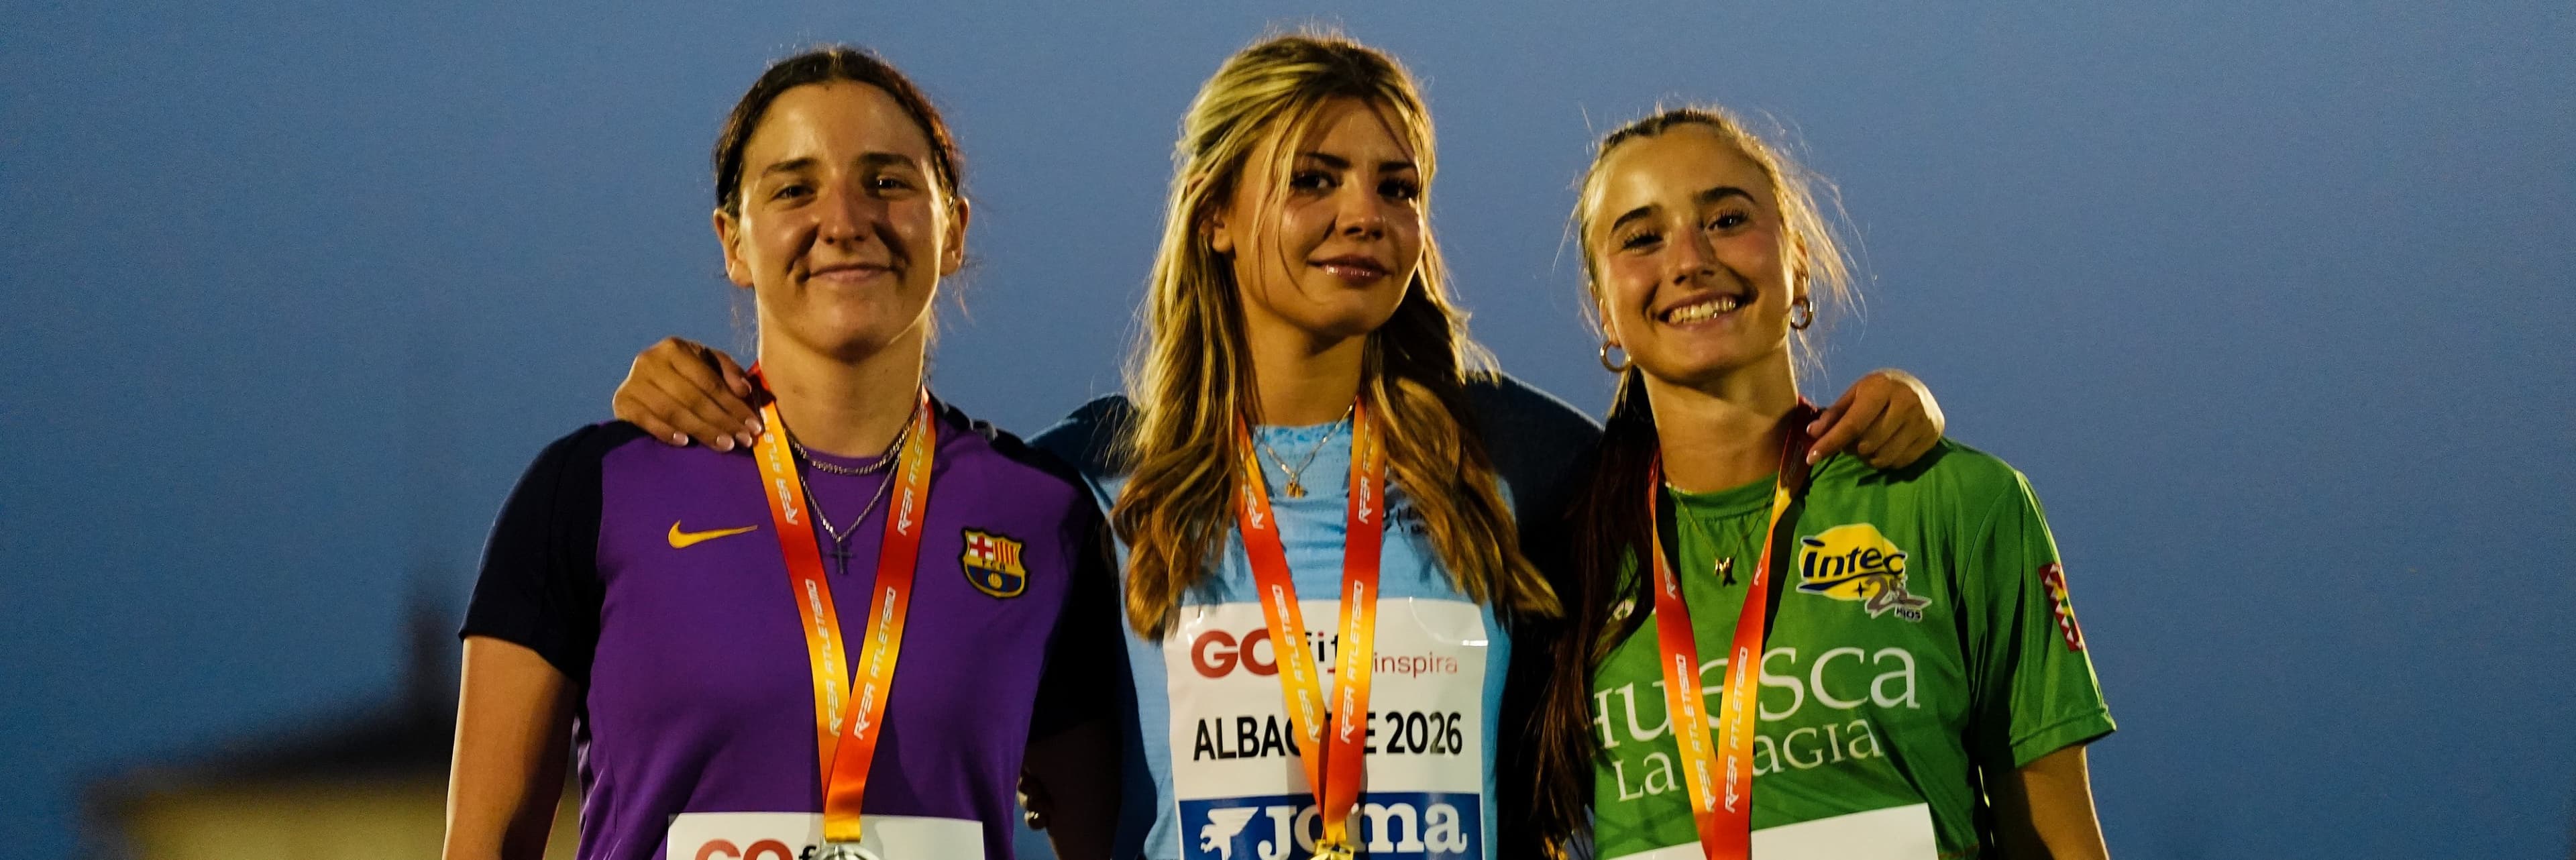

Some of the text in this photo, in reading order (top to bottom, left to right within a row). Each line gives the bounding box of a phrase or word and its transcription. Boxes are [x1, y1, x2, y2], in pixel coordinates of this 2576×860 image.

[1374, 651, 1458, 679] inspira
[853, 682, 875, 741] RFEA
[1341, 685, 1356, 745] RFEA
[1385, 710, 1463, 756] 2026
[1612, 751, 1680, 802] La
